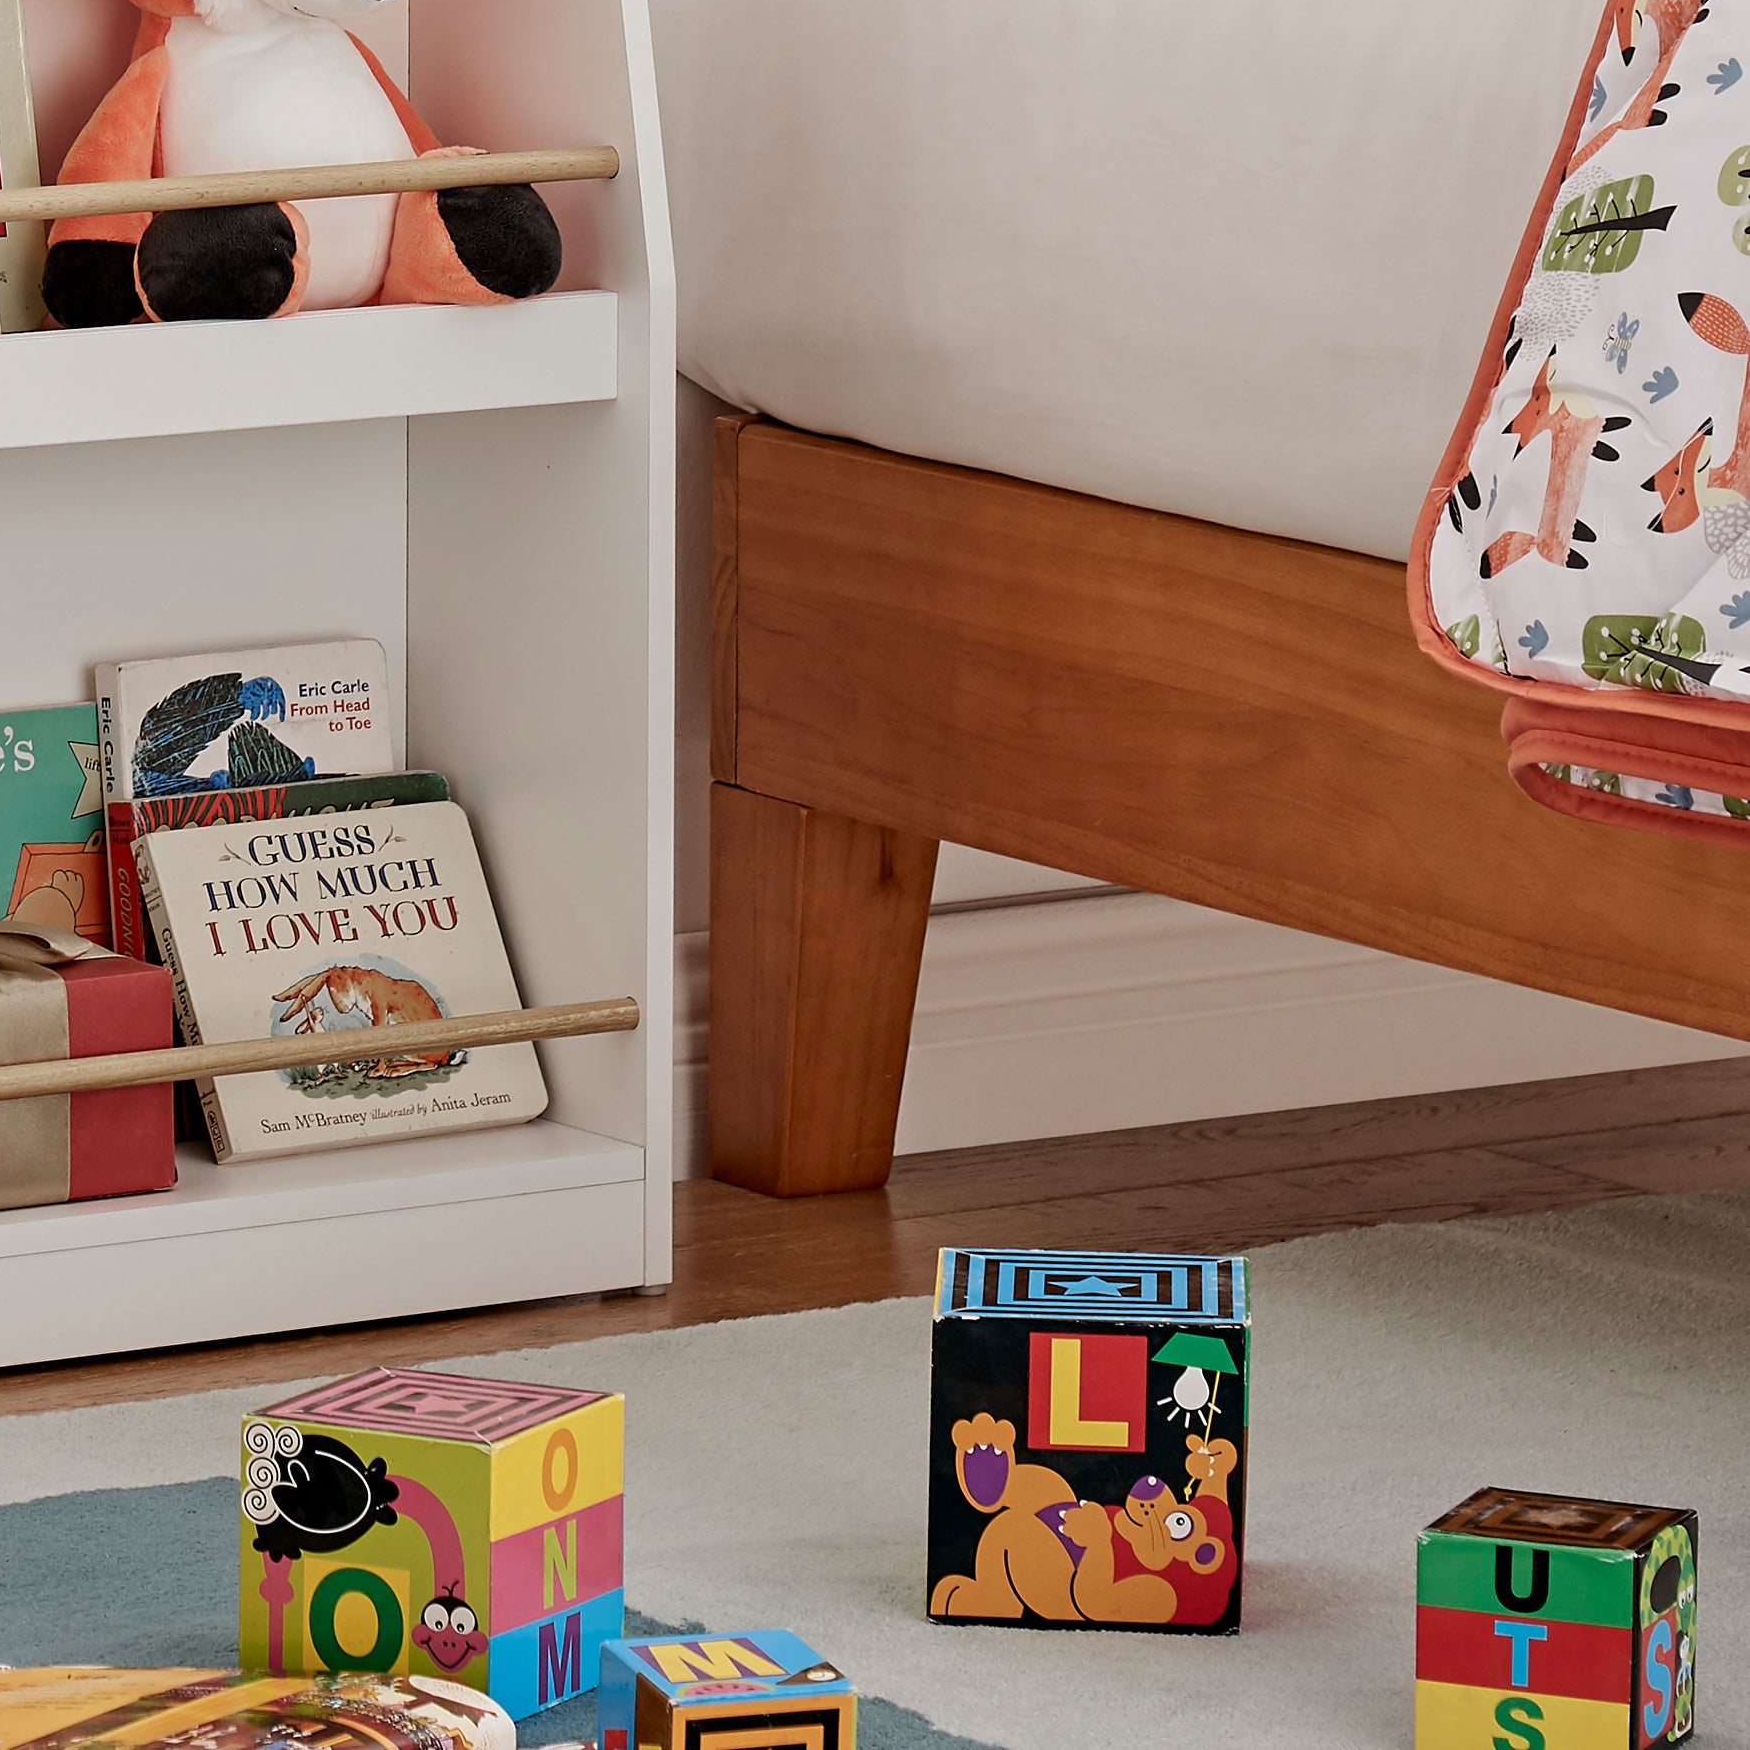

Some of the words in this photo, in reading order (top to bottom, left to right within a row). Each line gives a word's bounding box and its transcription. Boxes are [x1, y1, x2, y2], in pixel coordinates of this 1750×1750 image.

[101, 697, 112, 734] Eric
[290, 703, 328, 716] From
[333, 697, 370, 713] Head
[298, 682, 326, 697] Eric
[331, 679, 369, 694] Carle
[329, 721, 343, 731] to
[346, 716, 371, 730] Toe
[104, 740, 115, 793] Carle
[248, 824, 376, 866] GUESS
[117, 867, 134, 958] GOODNI
[203, 872, 299, 912] HOW
[316, 857, 442, 900] MUCH
[205, 921, 227, 956] I
[238, 908, 359, 954] LOVE
[363, 896, 459, 939] YOU
[161, 927, 179, 976] Guess
[175, 979, 191, 1018] How
[187, 1021, 201, 1046] Mu
[260, 1119, 290, 1134] Sam
[294, 1111, 367, 1131] McBratney
[370, 1104, 415, 1120] illustrated
[416, 1103, 428, 1116] by
[431, 1097, 467, 1113] Anita
[471, 1092, 512, 1108] Jeram
[1050, 1337, 1129, 1447] L
[541, 1428, 578, 1512] O
[542, 1519, 577, 1610] N
[1495, 1544, 1550, 1613] U
[308, 1567, 404, 1675] O
[537, 1612, 581, 1705] M
[648, 1640, 788, 1683] M
[1494, 1620, 1548, 1687] T
[1643, 1619, 1673, 1739] S
[1492, 1697, 1546, 1750] S
